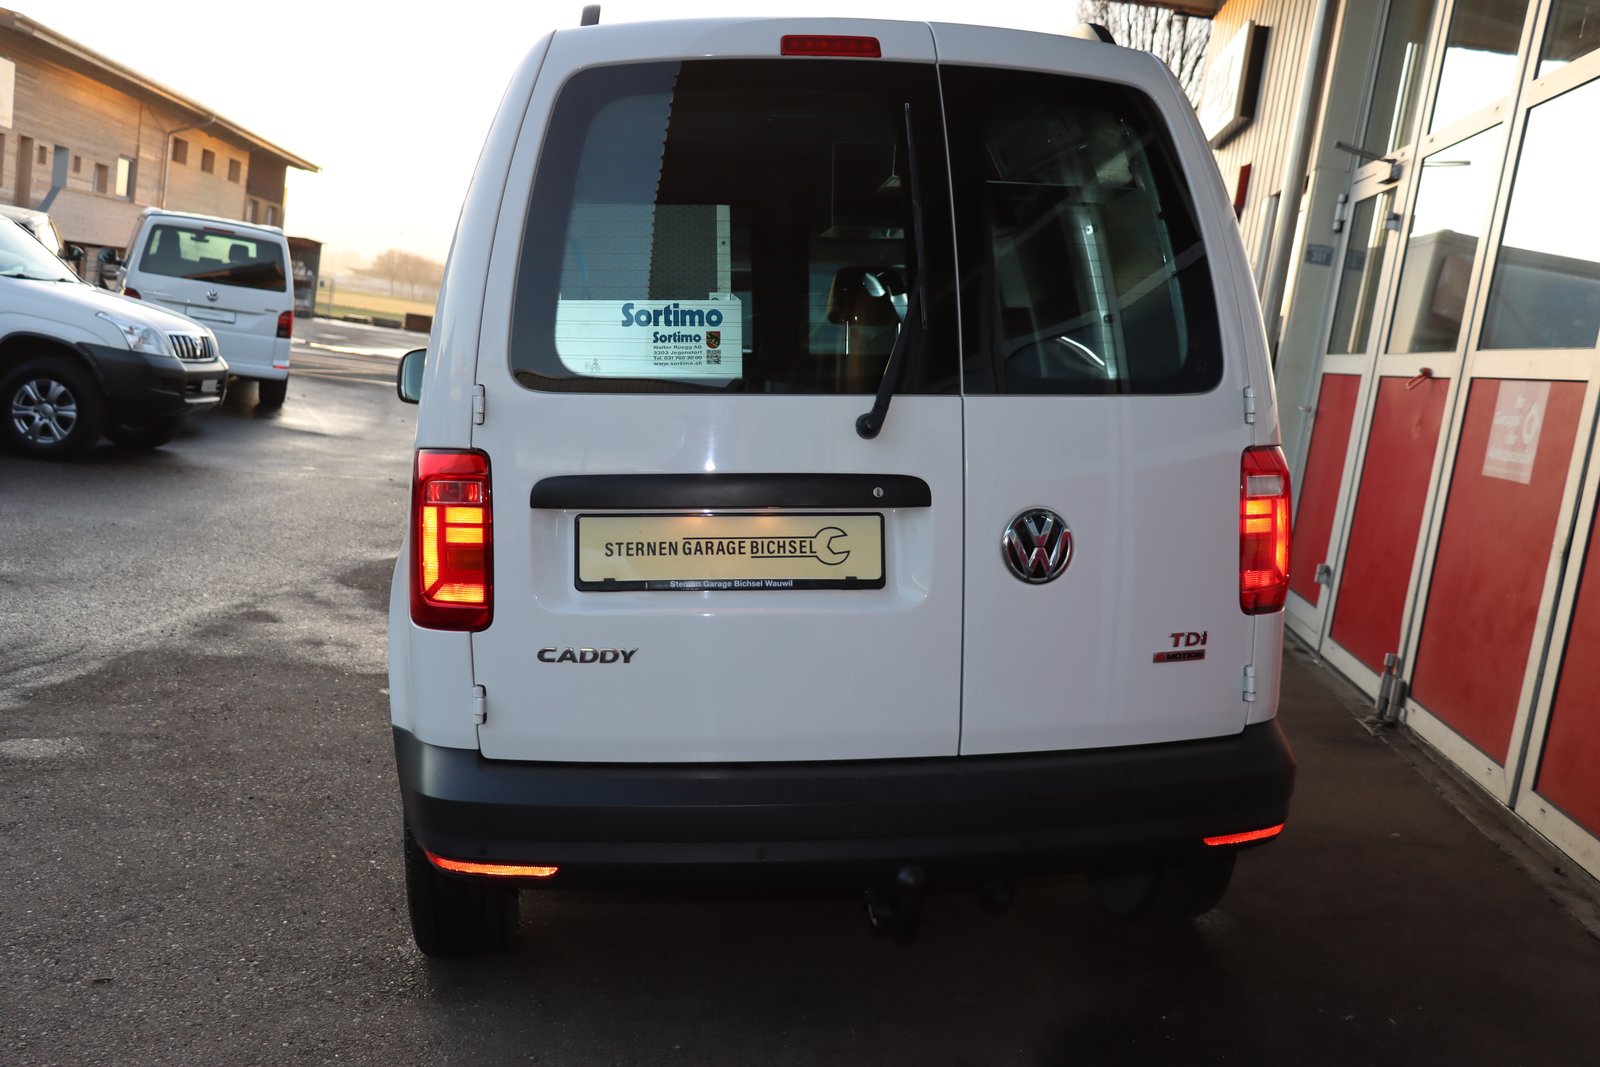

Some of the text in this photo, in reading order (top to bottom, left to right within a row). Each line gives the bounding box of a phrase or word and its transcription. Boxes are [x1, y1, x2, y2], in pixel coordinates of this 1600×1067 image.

[622, 302, 723, 327] Sortimo
[653, 331, 702, 343] Sortimo
[604, 540, 817, 557] STERNEN GARAGE BICHSEL
[703, 580, 732, 588] Garage
[536, 647, 639, 664] CADDY
